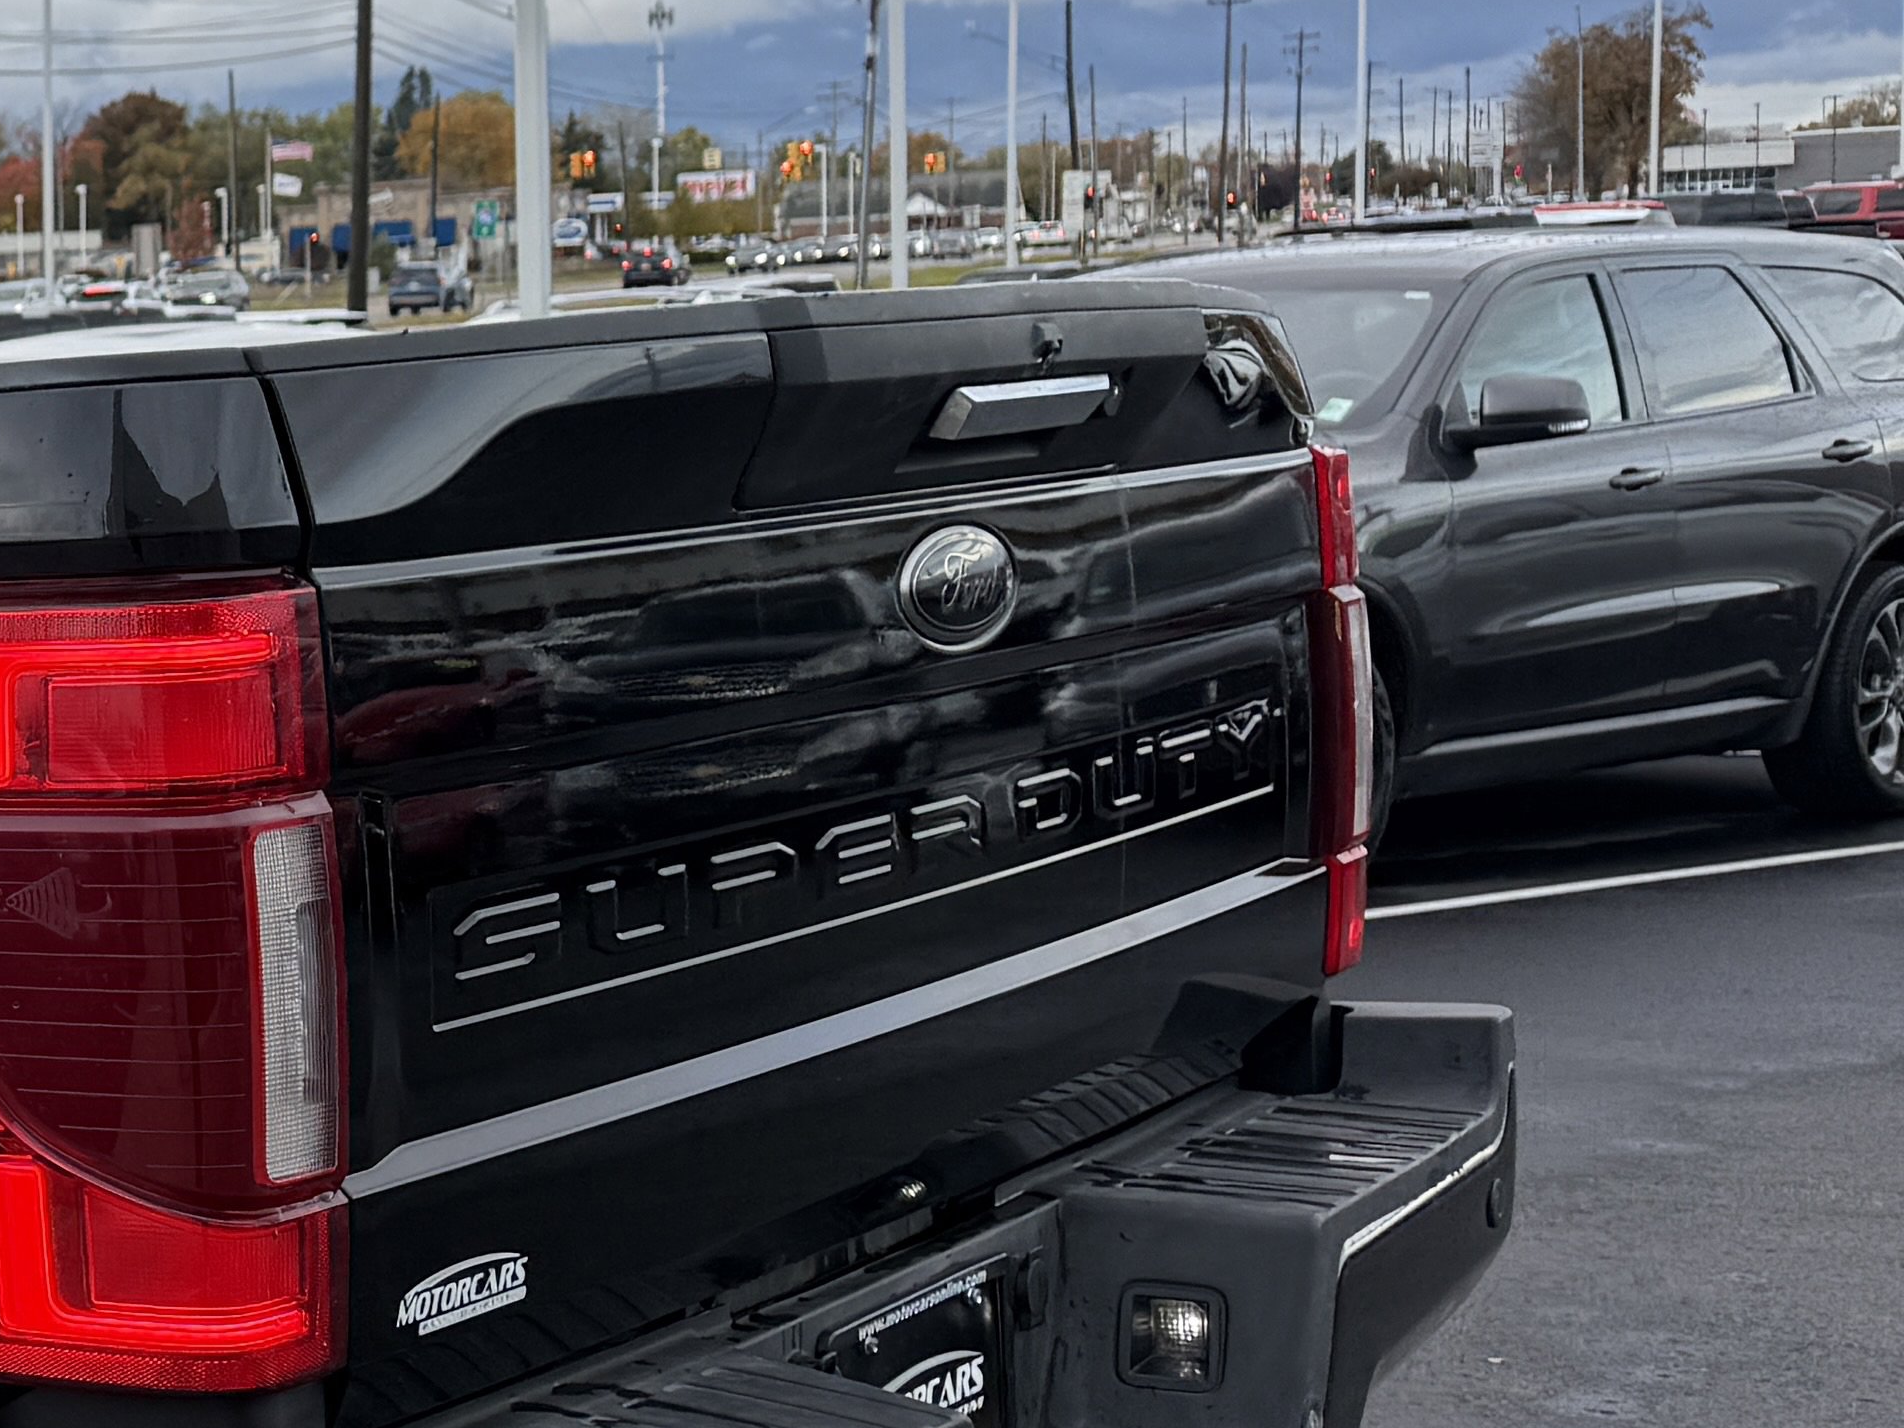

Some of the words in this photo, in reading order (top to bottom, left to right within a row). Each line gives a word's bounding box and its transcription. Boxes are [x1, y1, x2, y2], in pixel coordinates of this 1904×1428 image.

[452, 793, 985, 984] SUPER
[1015, 698, 1271, 837] DUTY
[396, 1256, 529, 1328] MOTORCARS
[858, 1269, 988, 1342] www.motorcarsonline.com
[904, 1355, 985, 1408] RCARS
